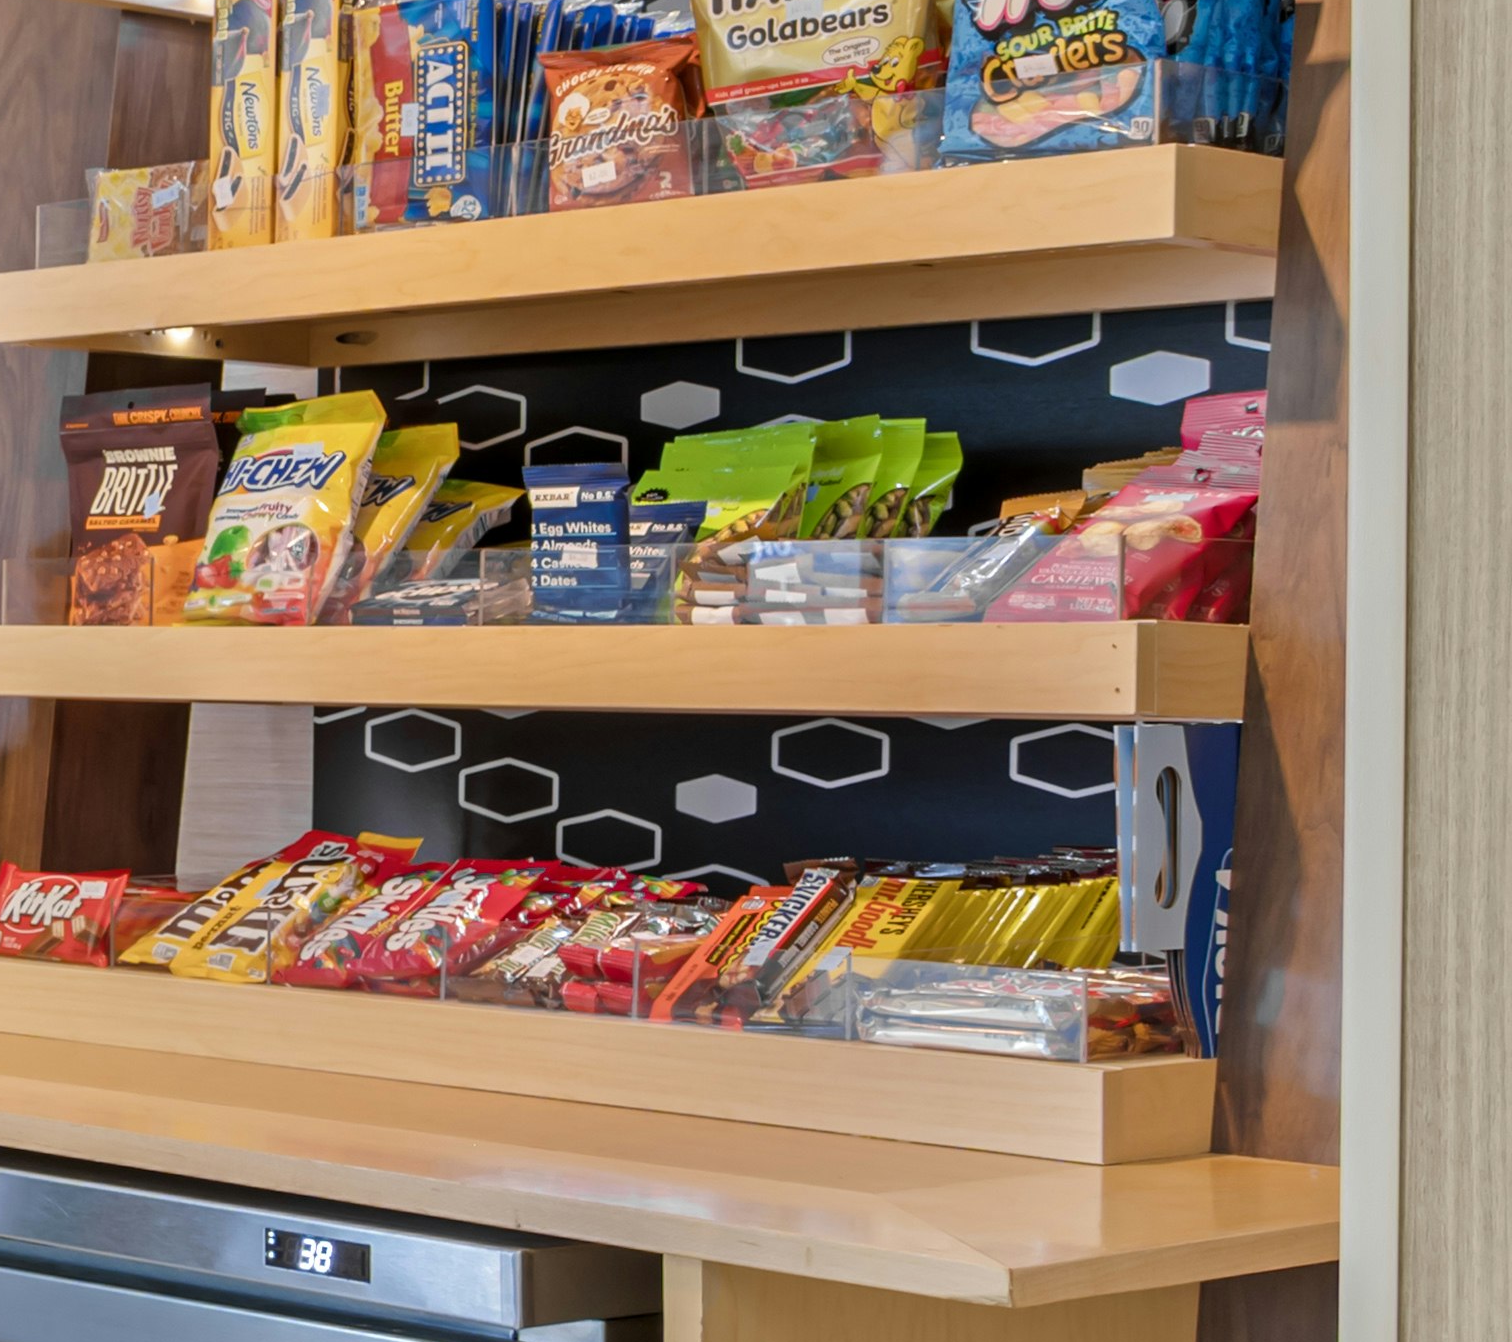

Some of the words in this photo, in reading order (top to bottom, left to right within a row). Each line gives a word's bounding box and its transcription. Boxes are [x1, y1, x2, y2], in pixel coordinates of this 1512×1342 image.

[842, 40, 871, 53] Original
[996, 26, 1054, 61] SOUR
[1058, 11, 1117, 37] BRITE
[426, 60, 454, 120] ACT
[241, 81, 259, 150] Newtons
[383, 79, 404, 157] Butter
[549, 105, 678, 170] Grandma's
[106, 447, 177, 464] BROWNIE
[535, 492, 572, 502] RXBAR
[581, 491, 594, 500] No
[540, 523, 563, 536] Egg
[566, 521, 612, 534] Whites
[541, 575, 577, 587] Dates
[299, 1238, 333, 1273] 38
